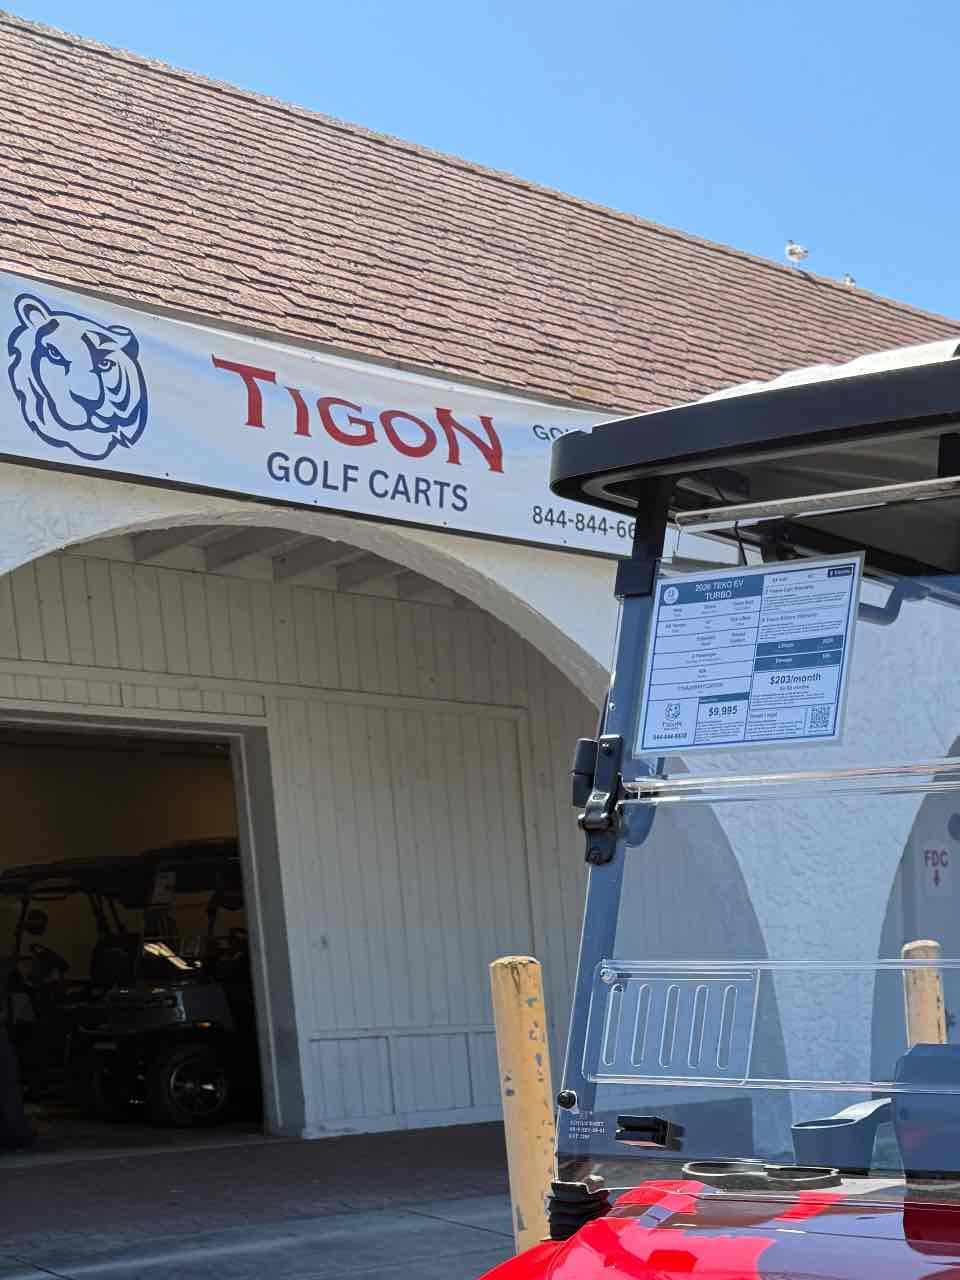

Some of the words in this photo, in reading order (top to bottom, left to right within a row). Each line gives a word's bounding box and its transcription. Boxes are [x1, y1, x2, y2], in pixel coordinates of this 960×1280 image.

[211, 353, 504, 474] TIGON
[266, 451, 359, 493] GOLF
[368, 469, 468, 512] CARTS
[532, 505, 637, 540] 844-844-66
[704, 590, 733, 601] TURBO
[769, 671, 822, 686] $203/month
[708, 704, 738, 718] $9,995
[924, 849, 949, 867] FDC
